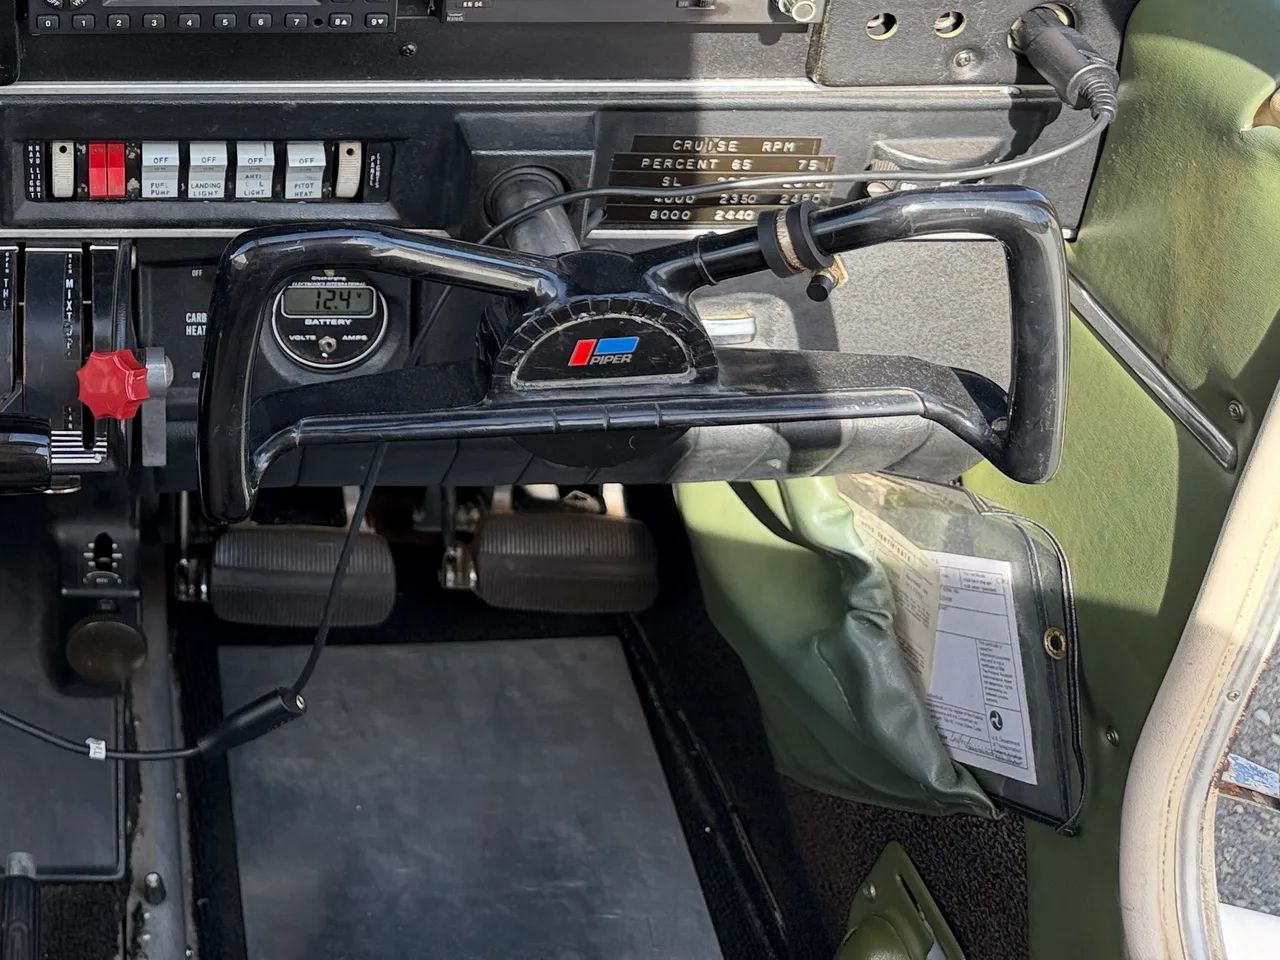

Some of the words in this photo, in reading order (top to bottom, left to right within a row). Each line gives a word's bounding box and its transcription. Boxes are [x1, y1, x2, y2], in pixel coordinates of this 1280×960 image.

[673, 140, 739, 152] CRUISE
[762, 141, 796, 153] RPM
[202, 156, 216, 164] OFF
[640, 158, 720, 170] PERCENT
[732, 159, 753, 170] 65
[798, 160, 819, 171] 75
[720, 194, 757, 204] 2350
[650, 210, 692, 220] 8000
[714, 210, 756, 220] 2440
[316, 290, 351, 310] 12.4
[186, 312, 207, 323] CARB
[186, 326, 206, 336] HEAT
[590, 354, 632, 364] PIPER
